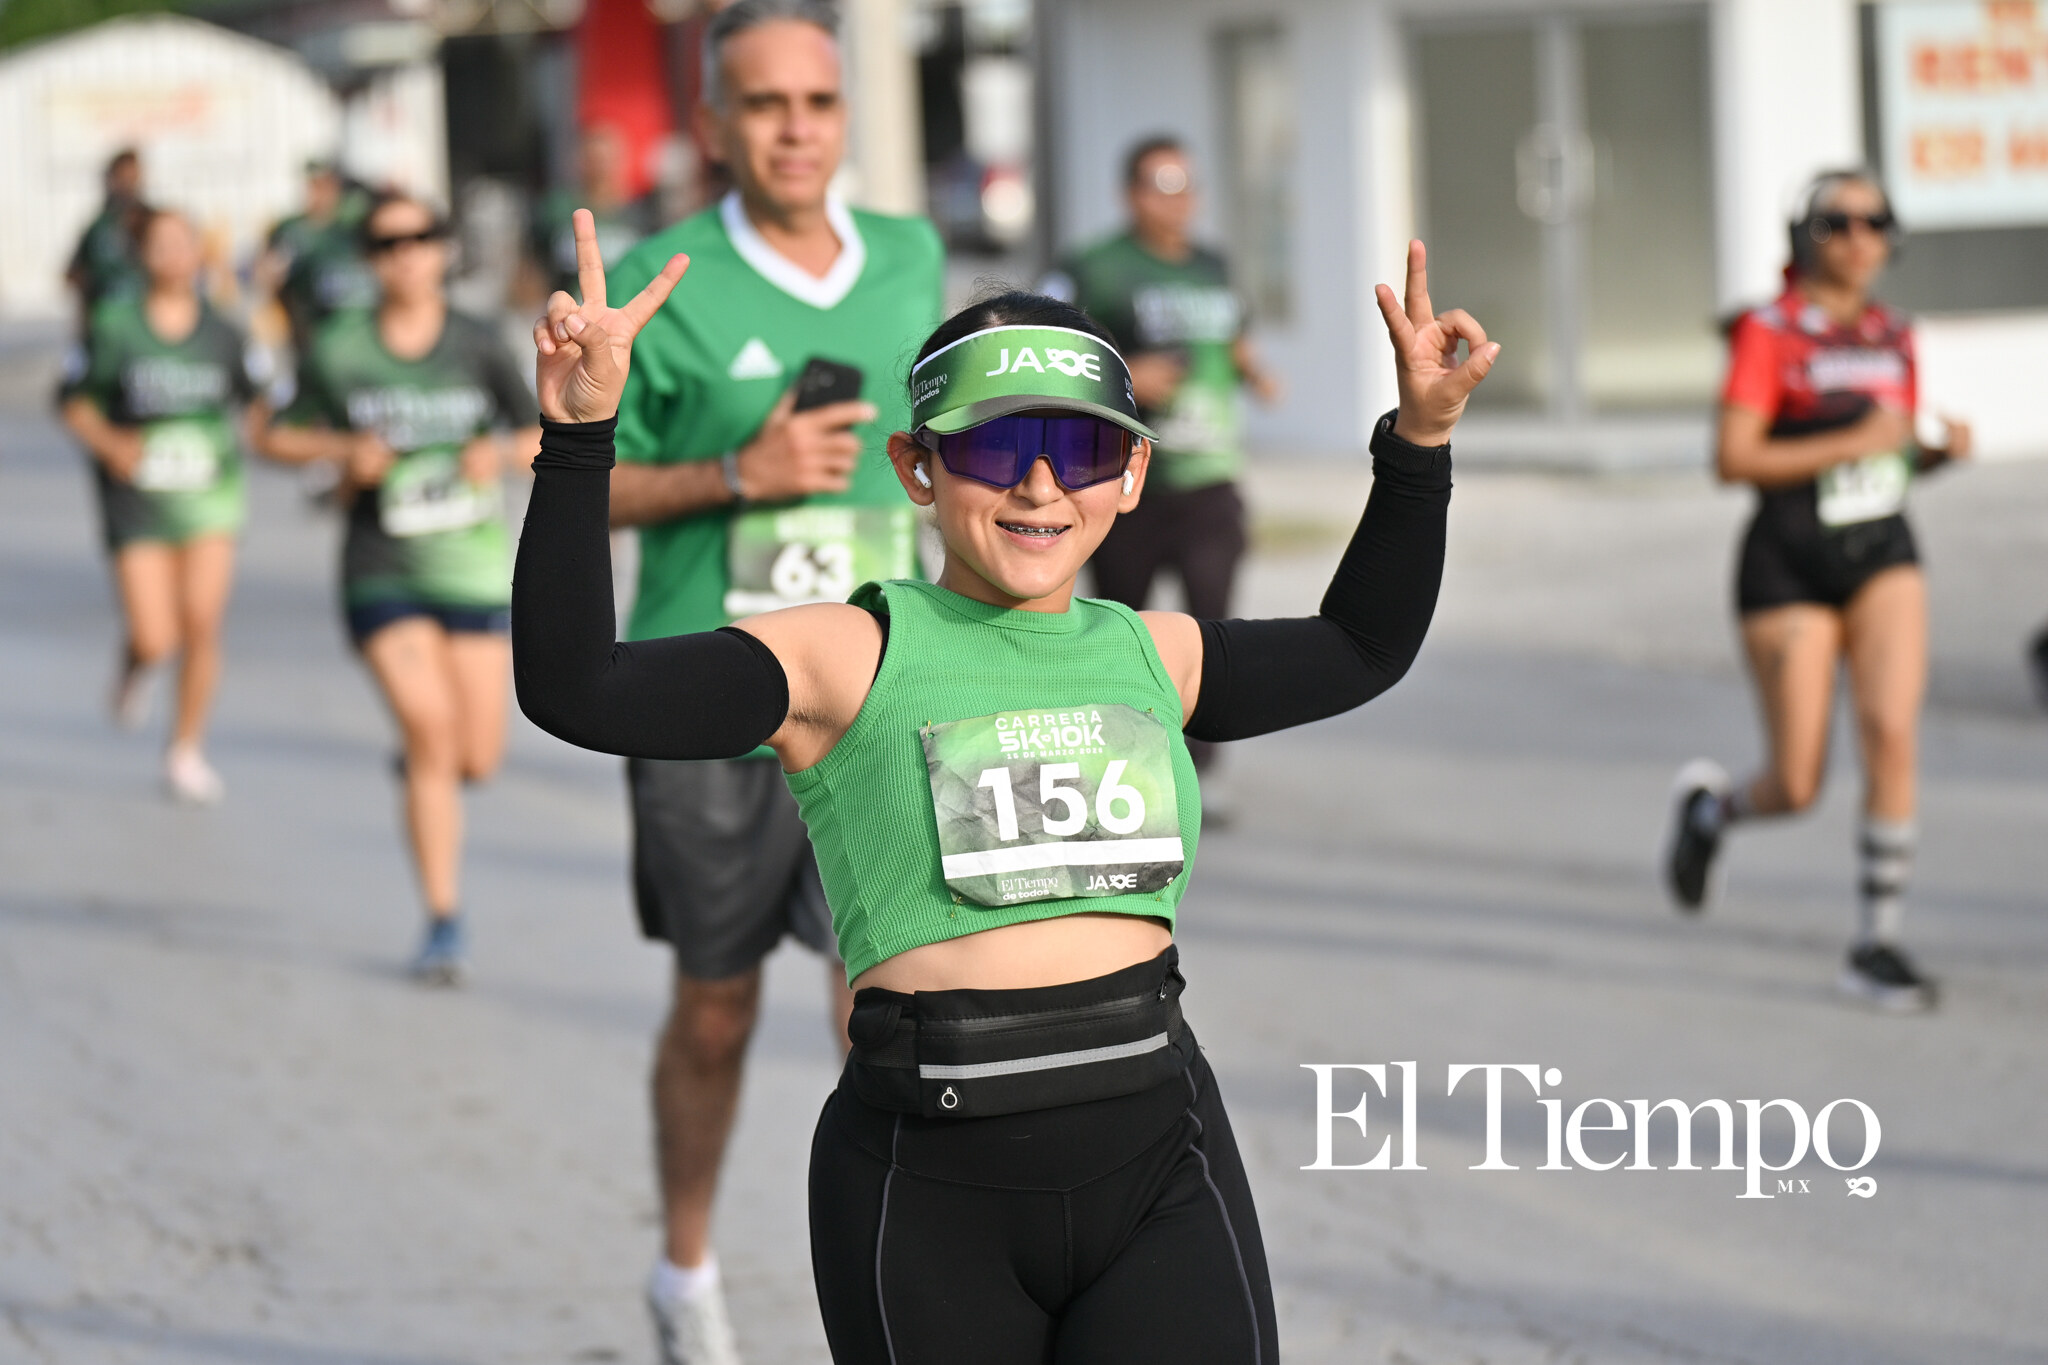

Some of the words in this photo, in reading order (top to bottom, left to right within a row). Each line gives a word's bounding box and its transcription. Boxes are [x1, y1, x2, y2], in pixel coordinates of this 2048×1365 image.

[770, 543, 852, 599] 63
[995, 710, 1102, 730] CARRERA
[1040, 748, 1074, 757] MARZO
[977, 759, 1146, 841] 156
[1001, 880, 1014, 892] El
[1015, 876, 1058, 889] Tiempo
[1003, 892, 1016, 900] de
[1019, 888, 1049, 898] todos
